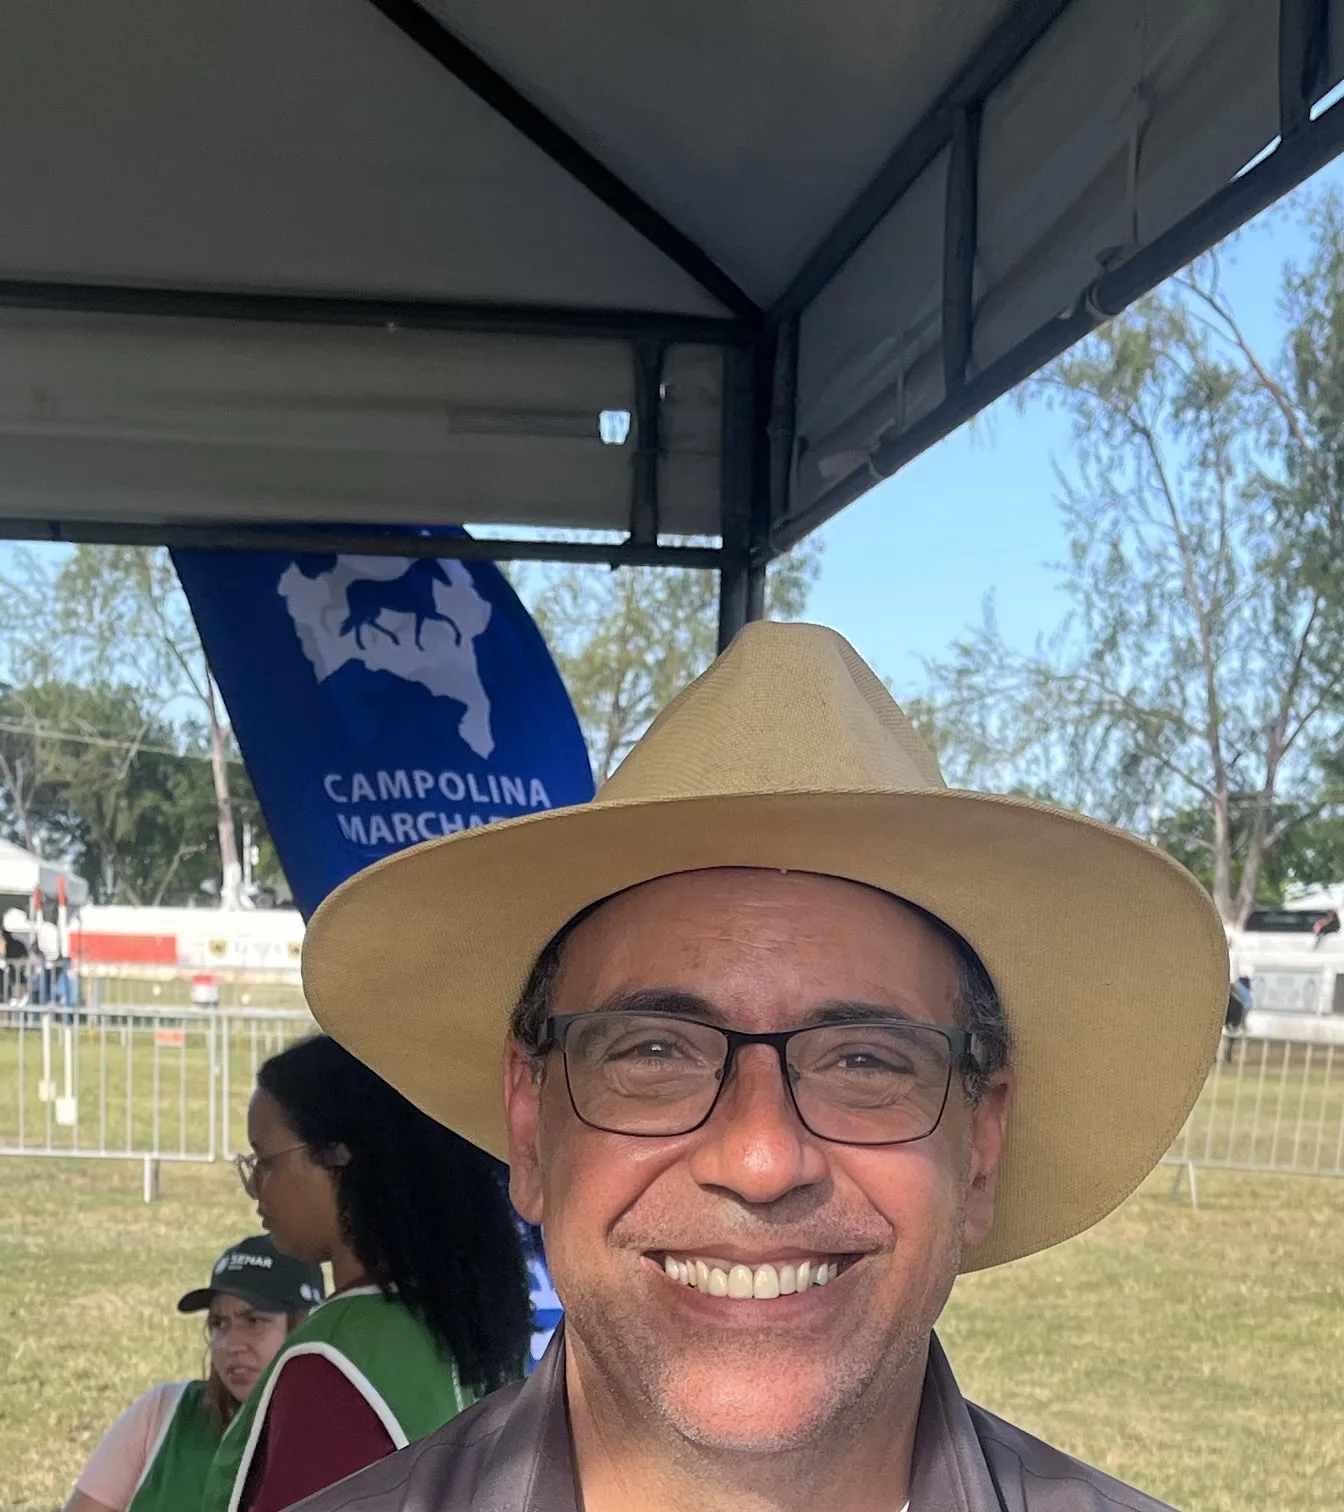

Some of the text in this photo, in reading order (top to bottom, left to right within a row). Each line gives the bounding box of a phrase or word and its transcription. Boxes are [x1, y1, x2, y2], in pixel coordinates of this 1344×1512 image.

[323, 768, 553, 810] CAMPOLINA
[337, 811, 511, 846] MARCH
[230, 1254, 274, 1270] SENAR
